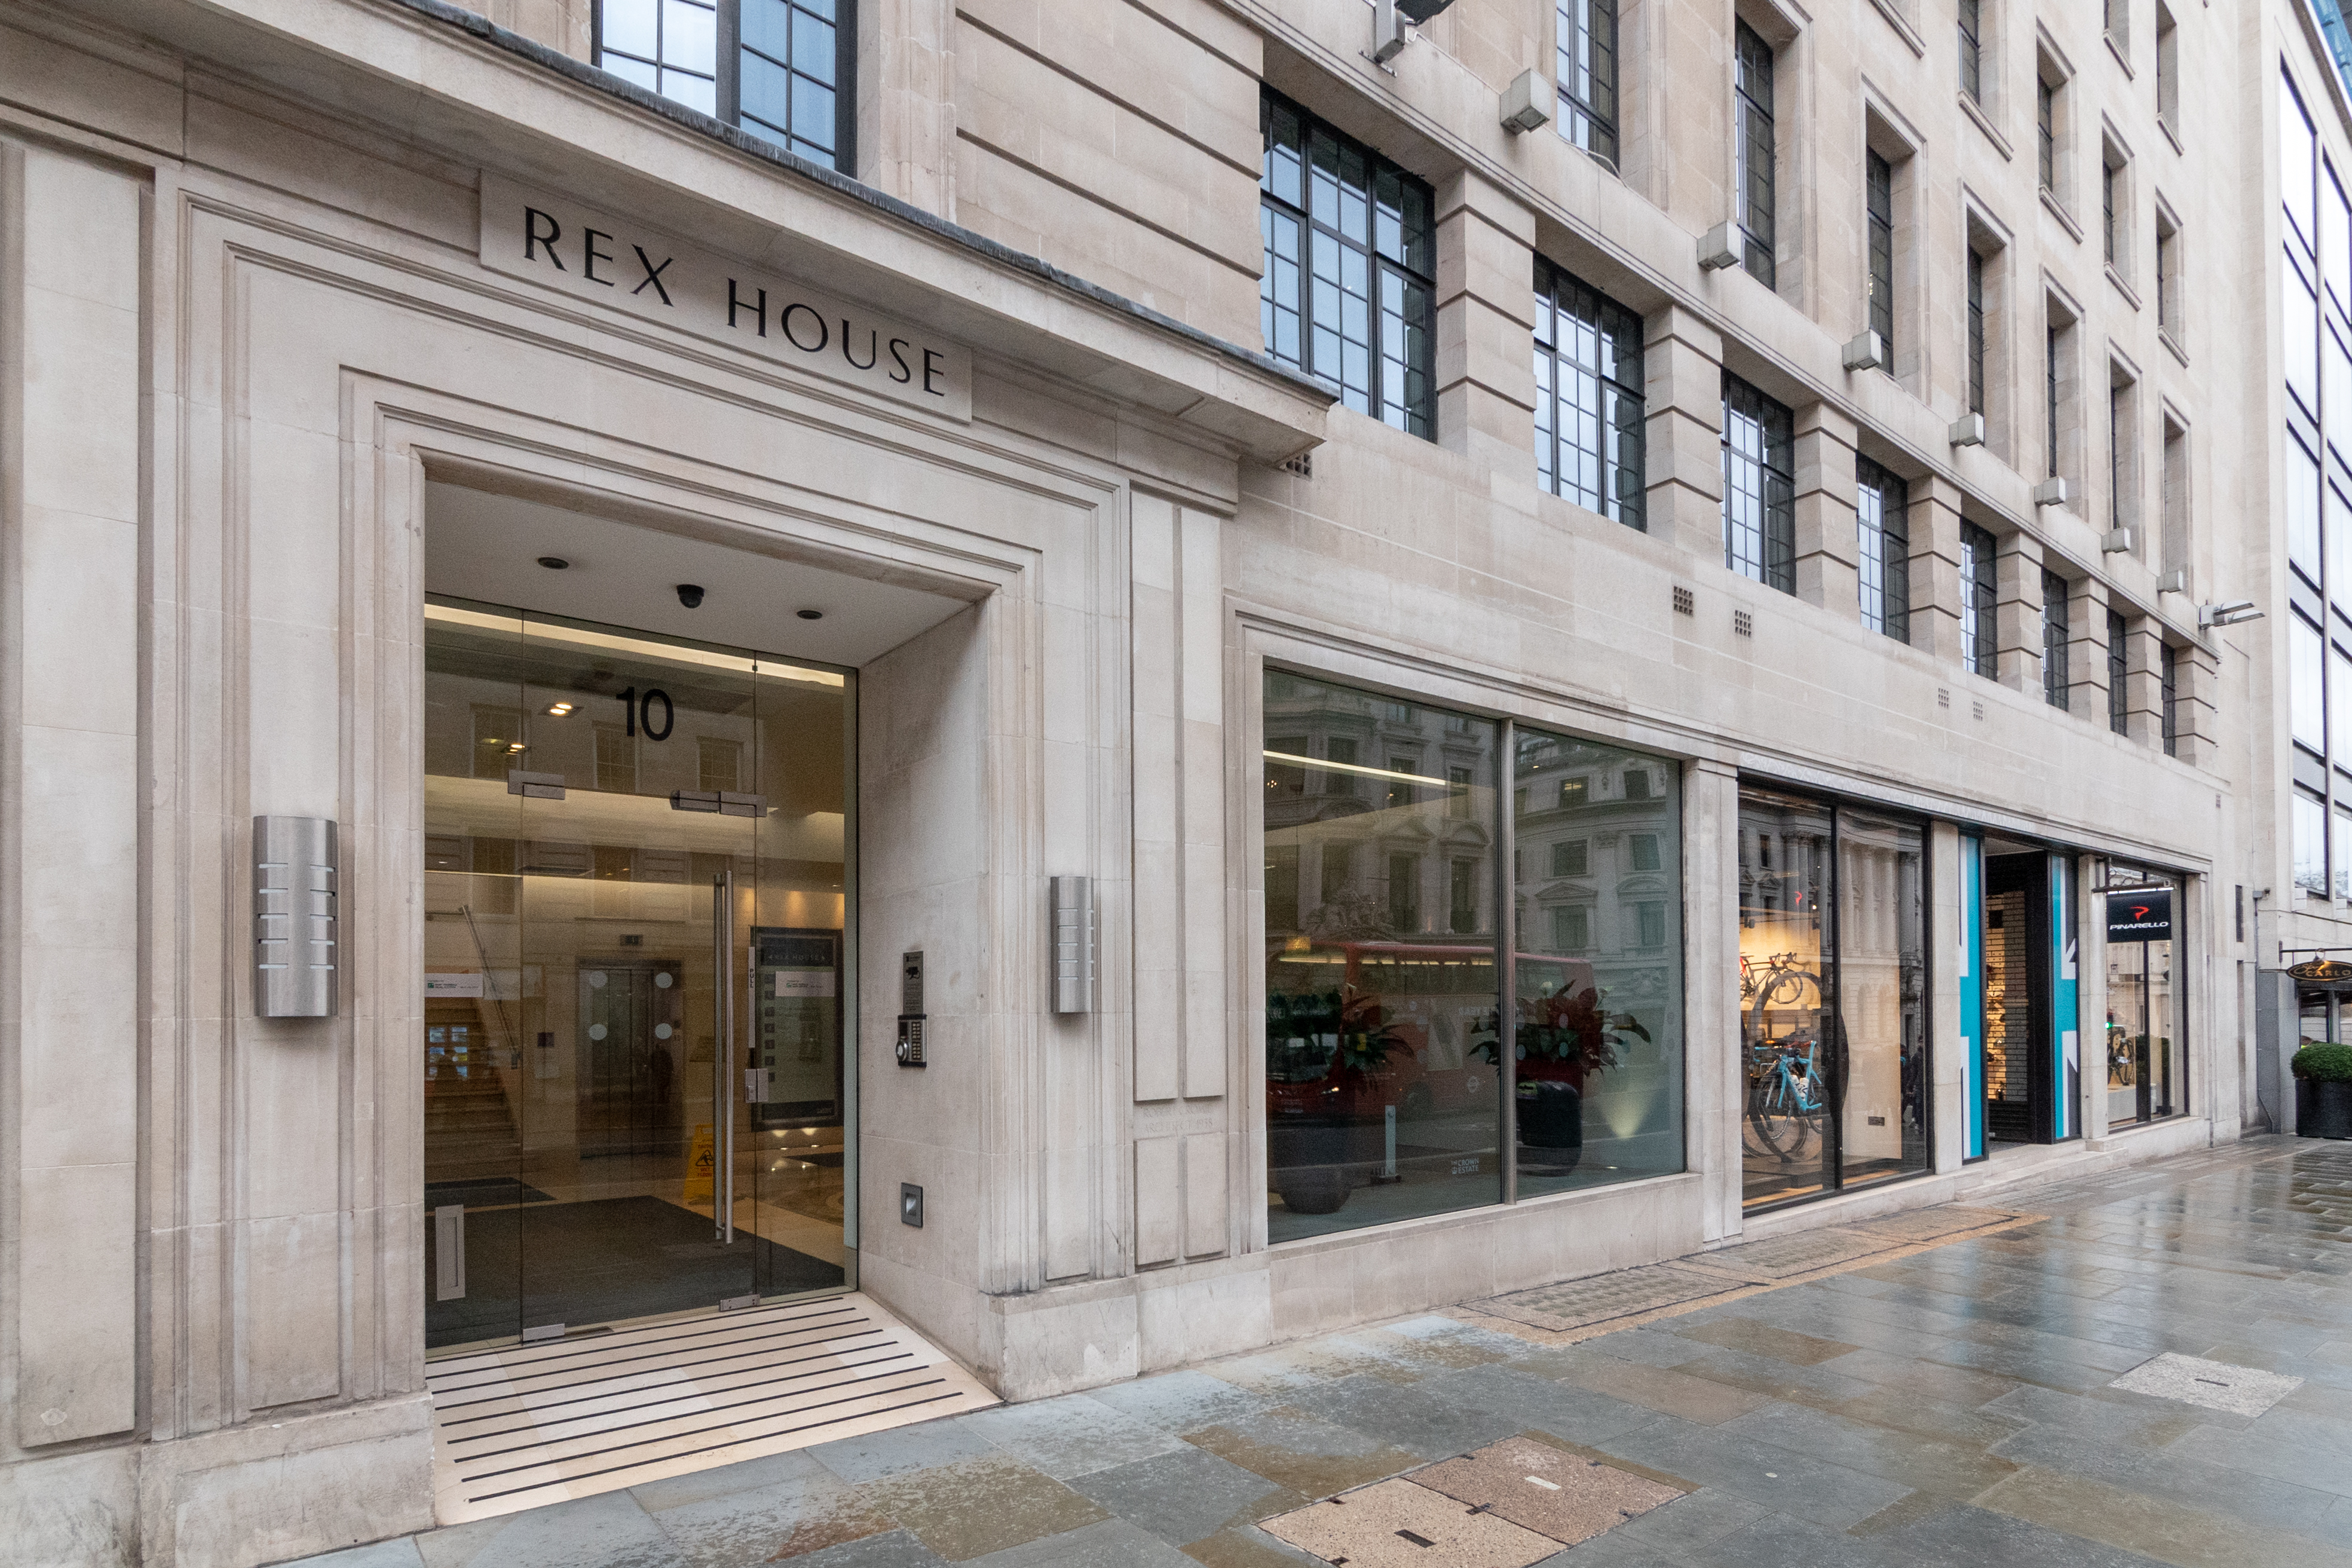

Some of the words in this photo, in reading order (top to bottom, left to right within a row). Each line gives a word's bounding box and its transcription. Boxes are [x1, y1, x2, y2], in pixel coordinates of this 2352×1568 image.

[523, 205, 674, 307] REX
[727, 278, 946, 397] HOUSE
[615, 685, 675, 742] 10
[2109, 921, 2169, 930] PINARELLO
[1457, 1157, 1480, 1166] CROWN
[1457, 1165, 1480, 1174] ESTATE
